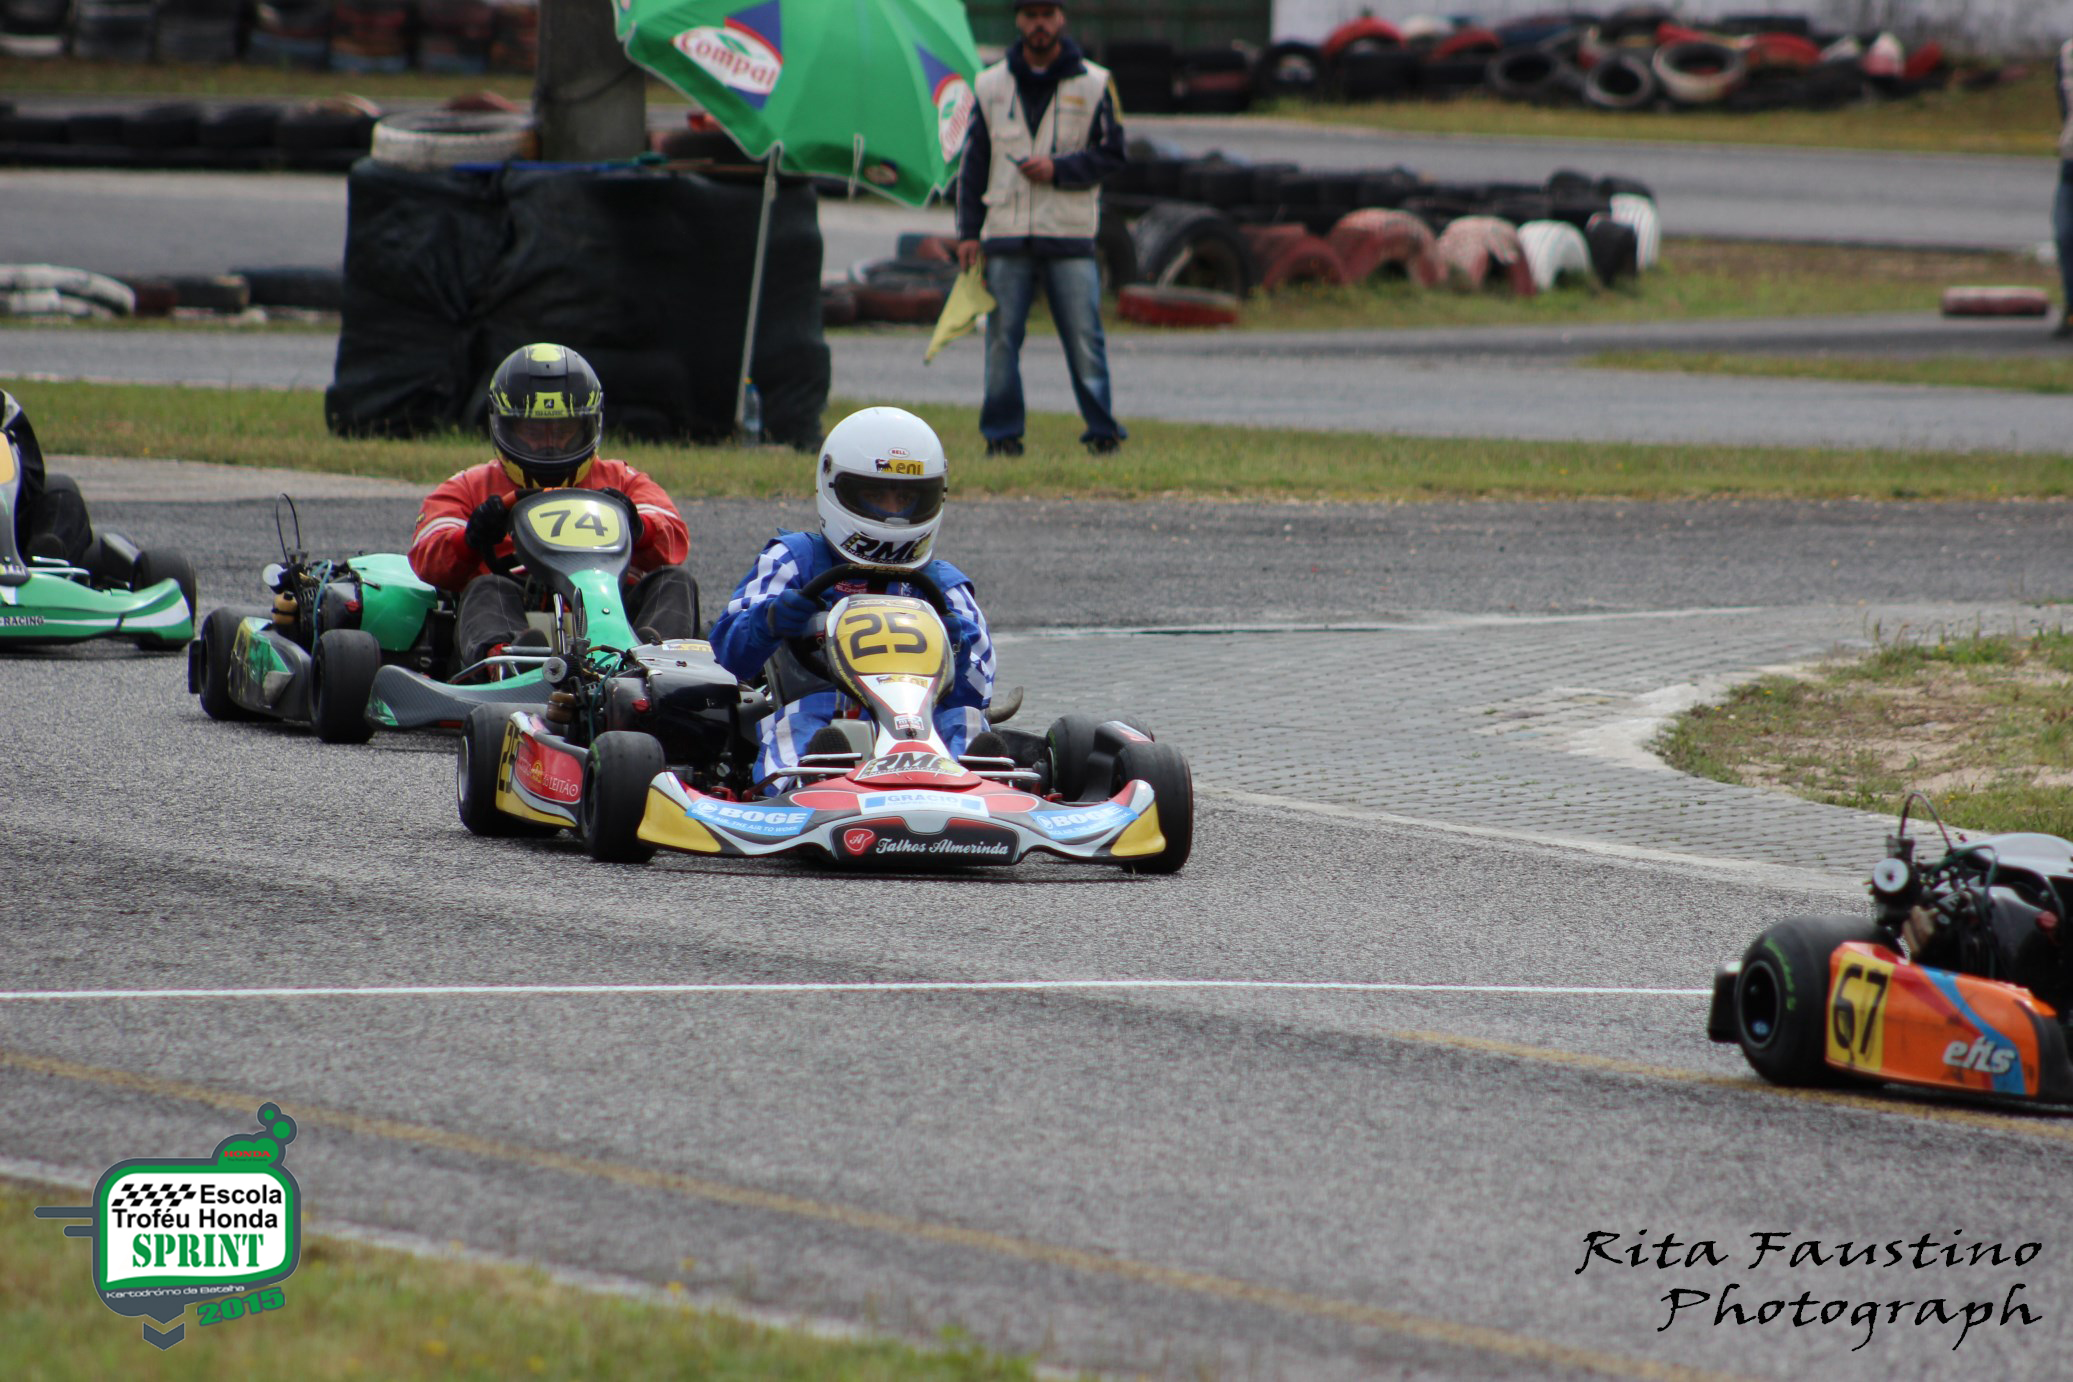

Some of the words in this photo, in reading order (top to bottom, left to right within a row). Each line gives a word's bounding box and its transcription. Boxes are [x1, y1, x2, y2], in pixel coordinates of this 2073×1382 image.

[680, 32, 777, 87] Compal
[896, 463, 921, 476] eni
[538, 509, 609, 538] 74
[844, 612, 928, 660] 25
[549, 778, 579, 797] LEITÃO
[718, 807, 808, 825] BOGE
[1050, 806, 1123, 827] BOGE
[876, 838, 926, 854] Talhos
[929, 839, 1009, 855] Almerinda
[1833, 963, 1888, 1055] 67
